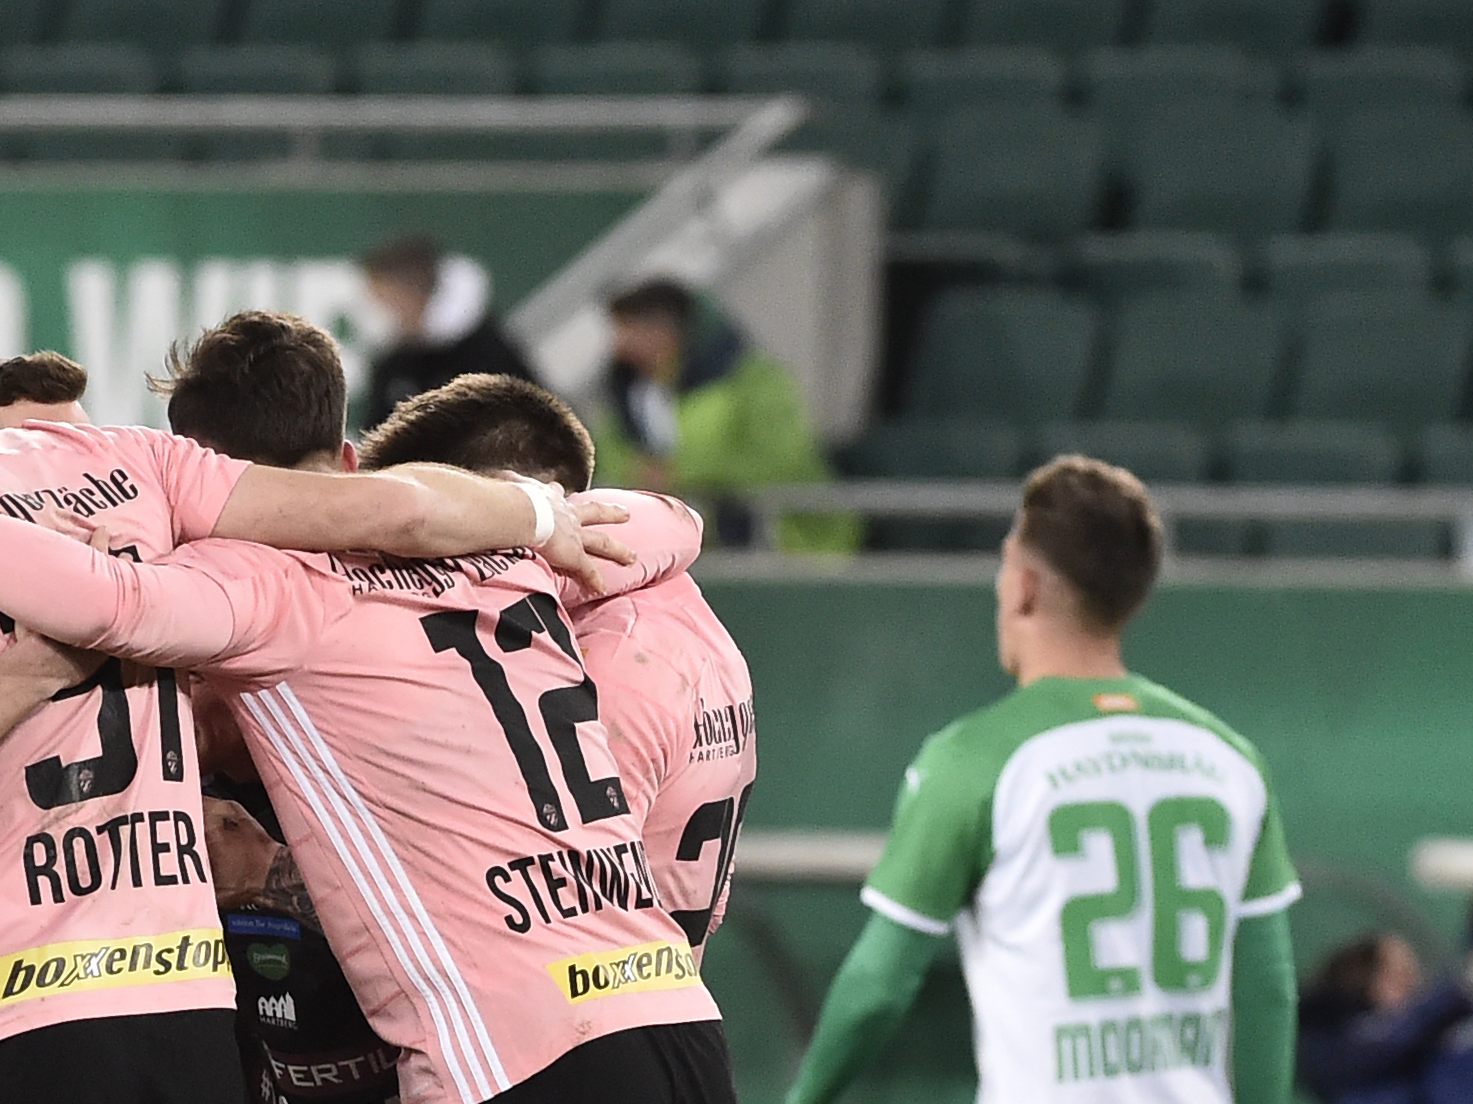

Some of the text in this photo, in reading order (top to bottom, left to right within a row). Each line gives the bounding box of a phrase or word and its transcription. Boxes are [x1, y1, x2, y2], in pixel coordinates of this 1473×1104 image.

[419, 592, 631, 832] 12
[23, 810, 208, 907] ROTTER
[1048, 797, 1232, 1002] 26
[2, 934, 230, 1000] boxxenstop
